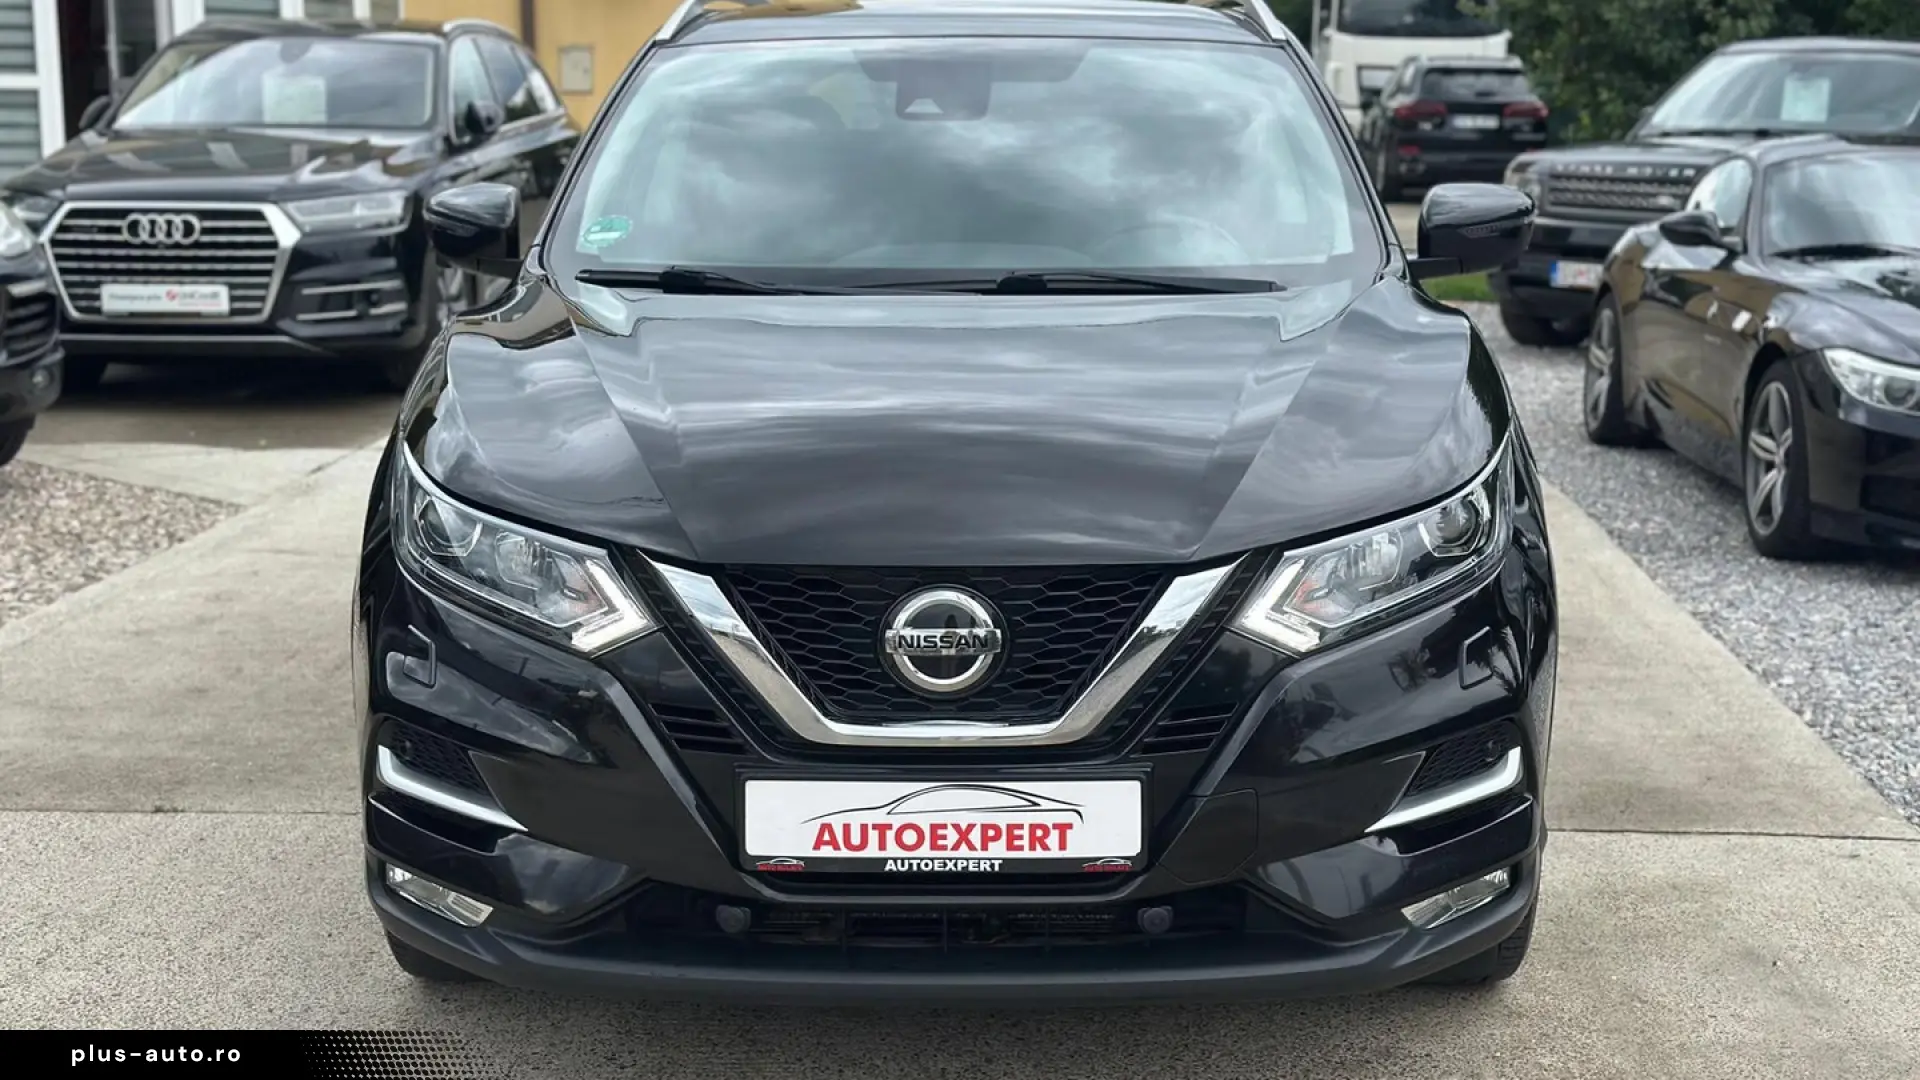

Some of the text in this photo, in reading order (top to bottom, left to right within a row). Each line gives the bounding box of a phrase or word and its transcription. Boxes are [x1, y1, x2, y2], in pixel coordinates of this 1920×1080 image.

[898, 634, 989, 649] NISSAN
[812, 822, 1074, 852] AUTOEXPERT
[884, 858, 1002, 872] AUTOEXPERT
